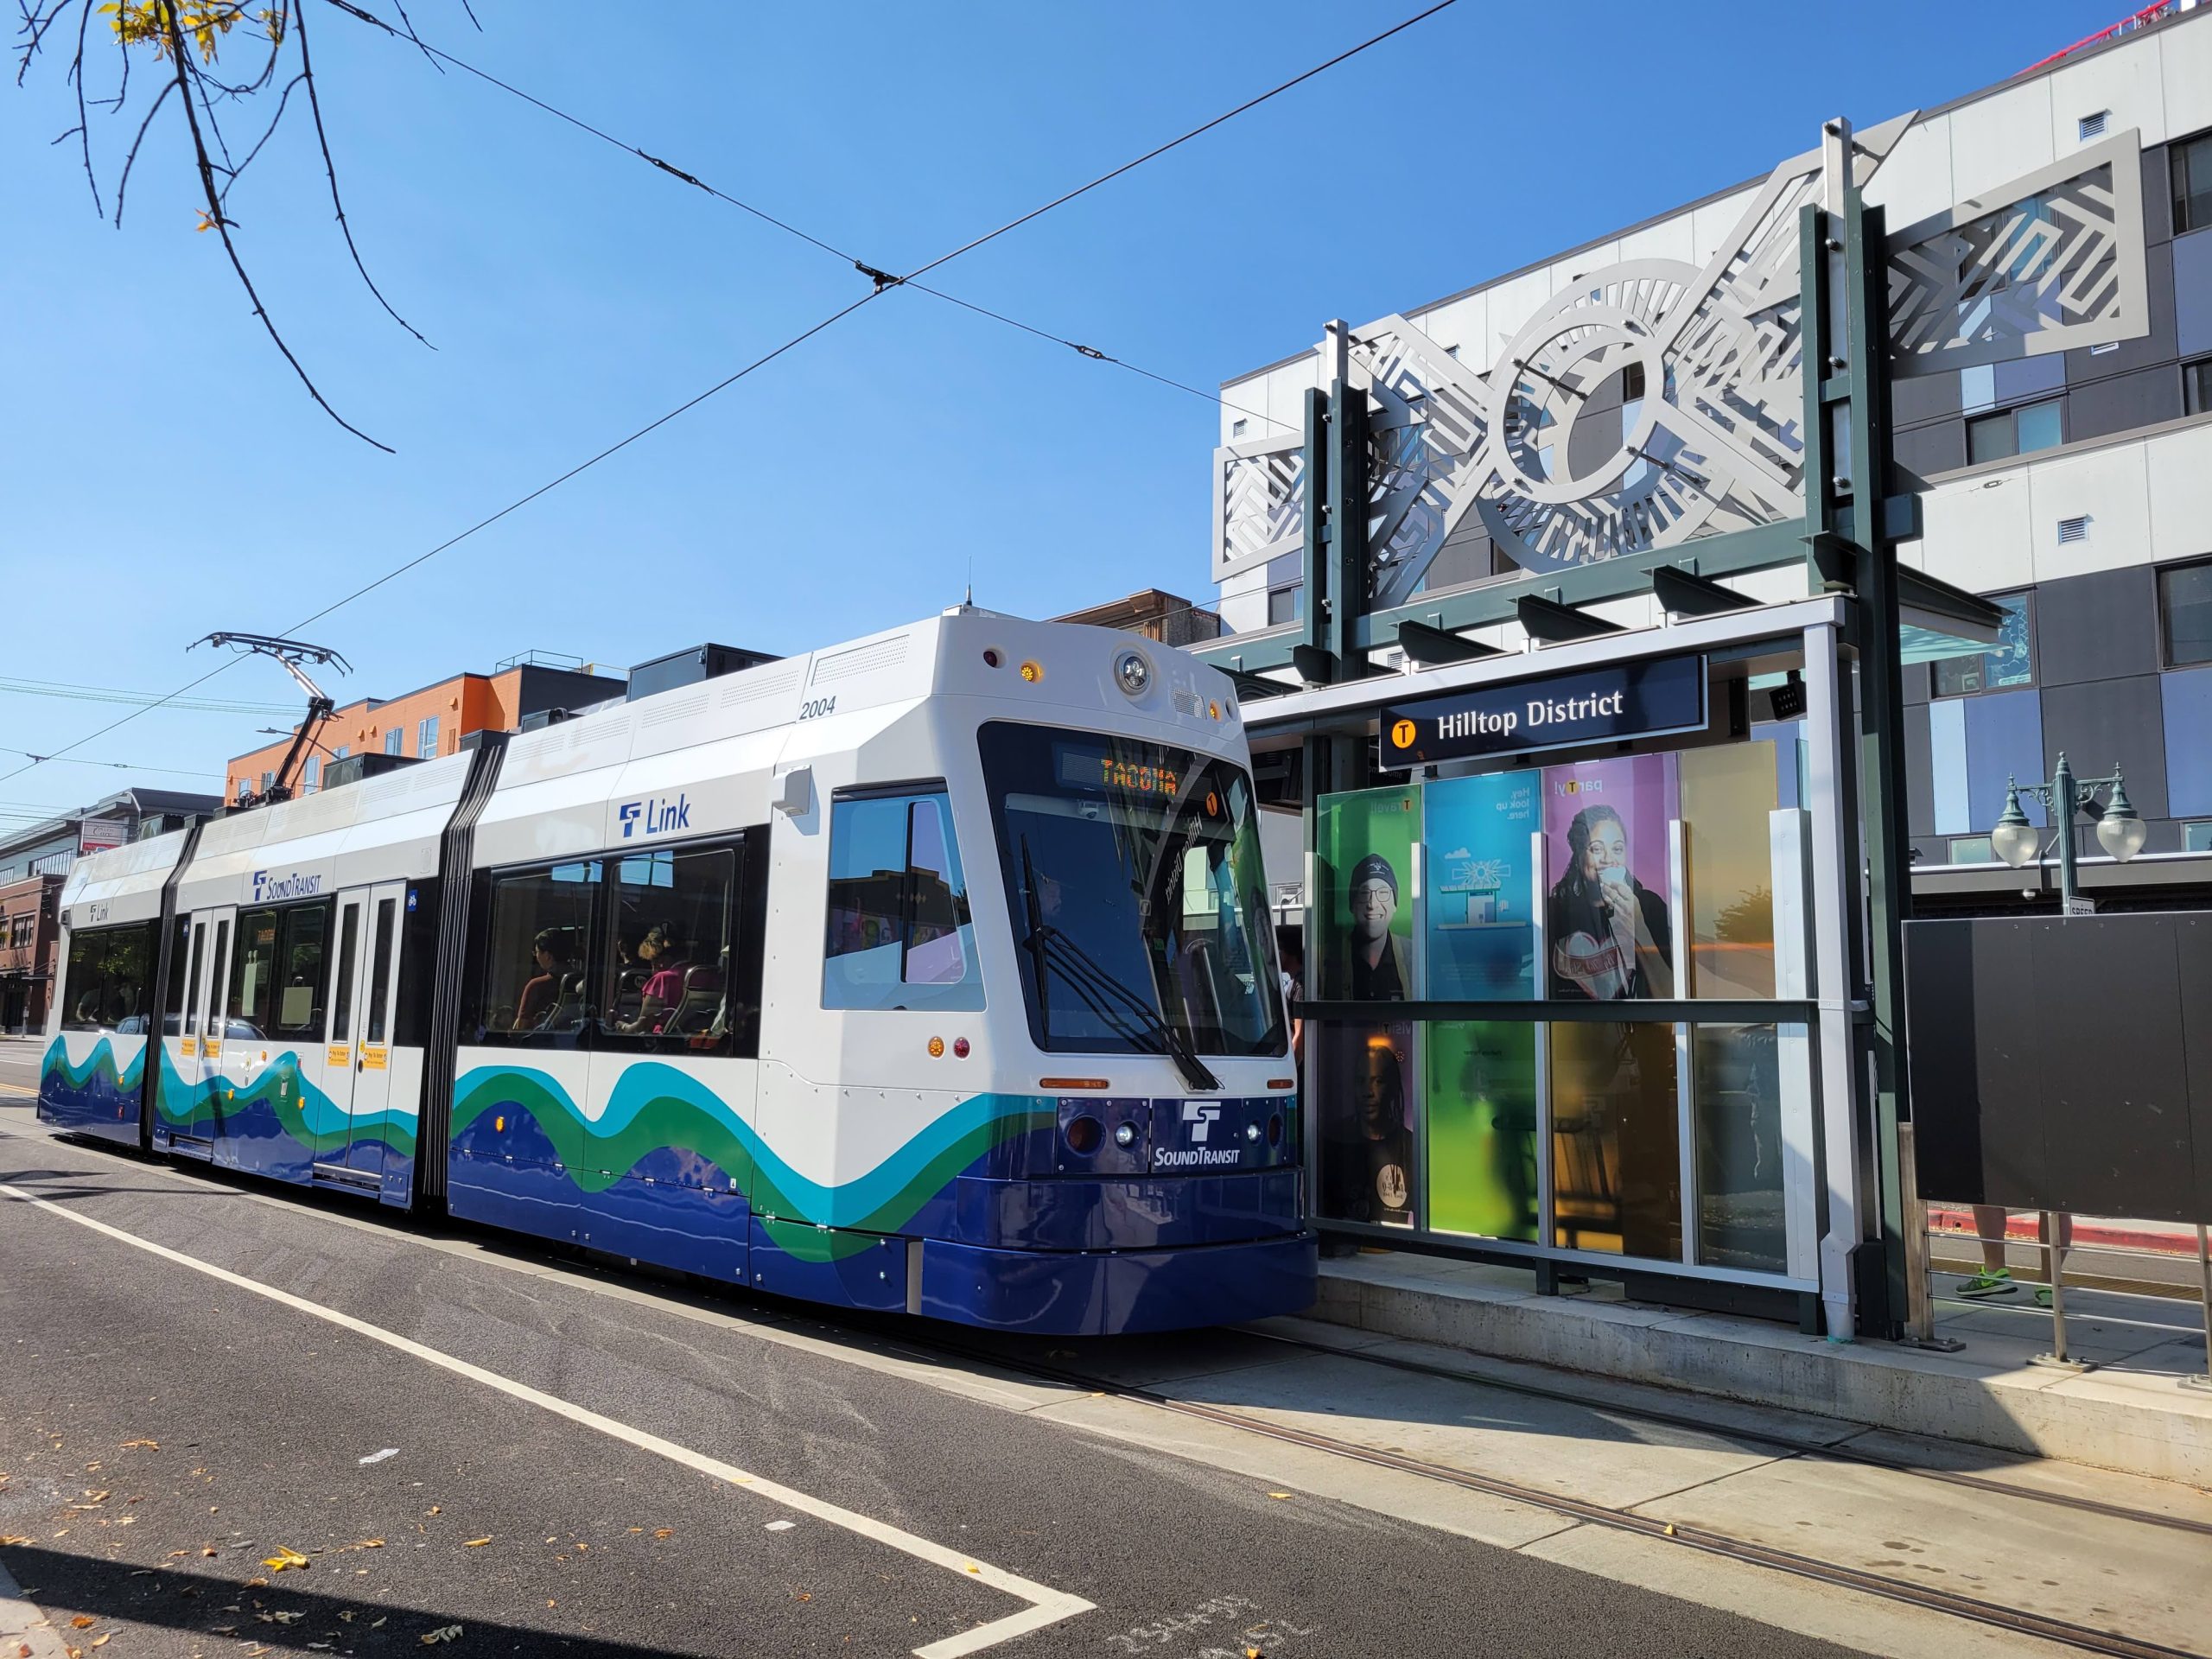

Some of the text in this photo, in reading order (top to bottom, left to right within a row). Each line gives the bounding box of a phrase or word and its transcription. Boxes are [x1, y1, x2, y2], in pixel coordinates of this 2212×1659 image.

[798, 695, 836, 721] 2004
[1437, 710, 1517, 740] Hilltop
[1527, 690, 1624, 727] District
[1101, 760, 1177, 796] TACOMA
[646, 793, 690, 835] Link
